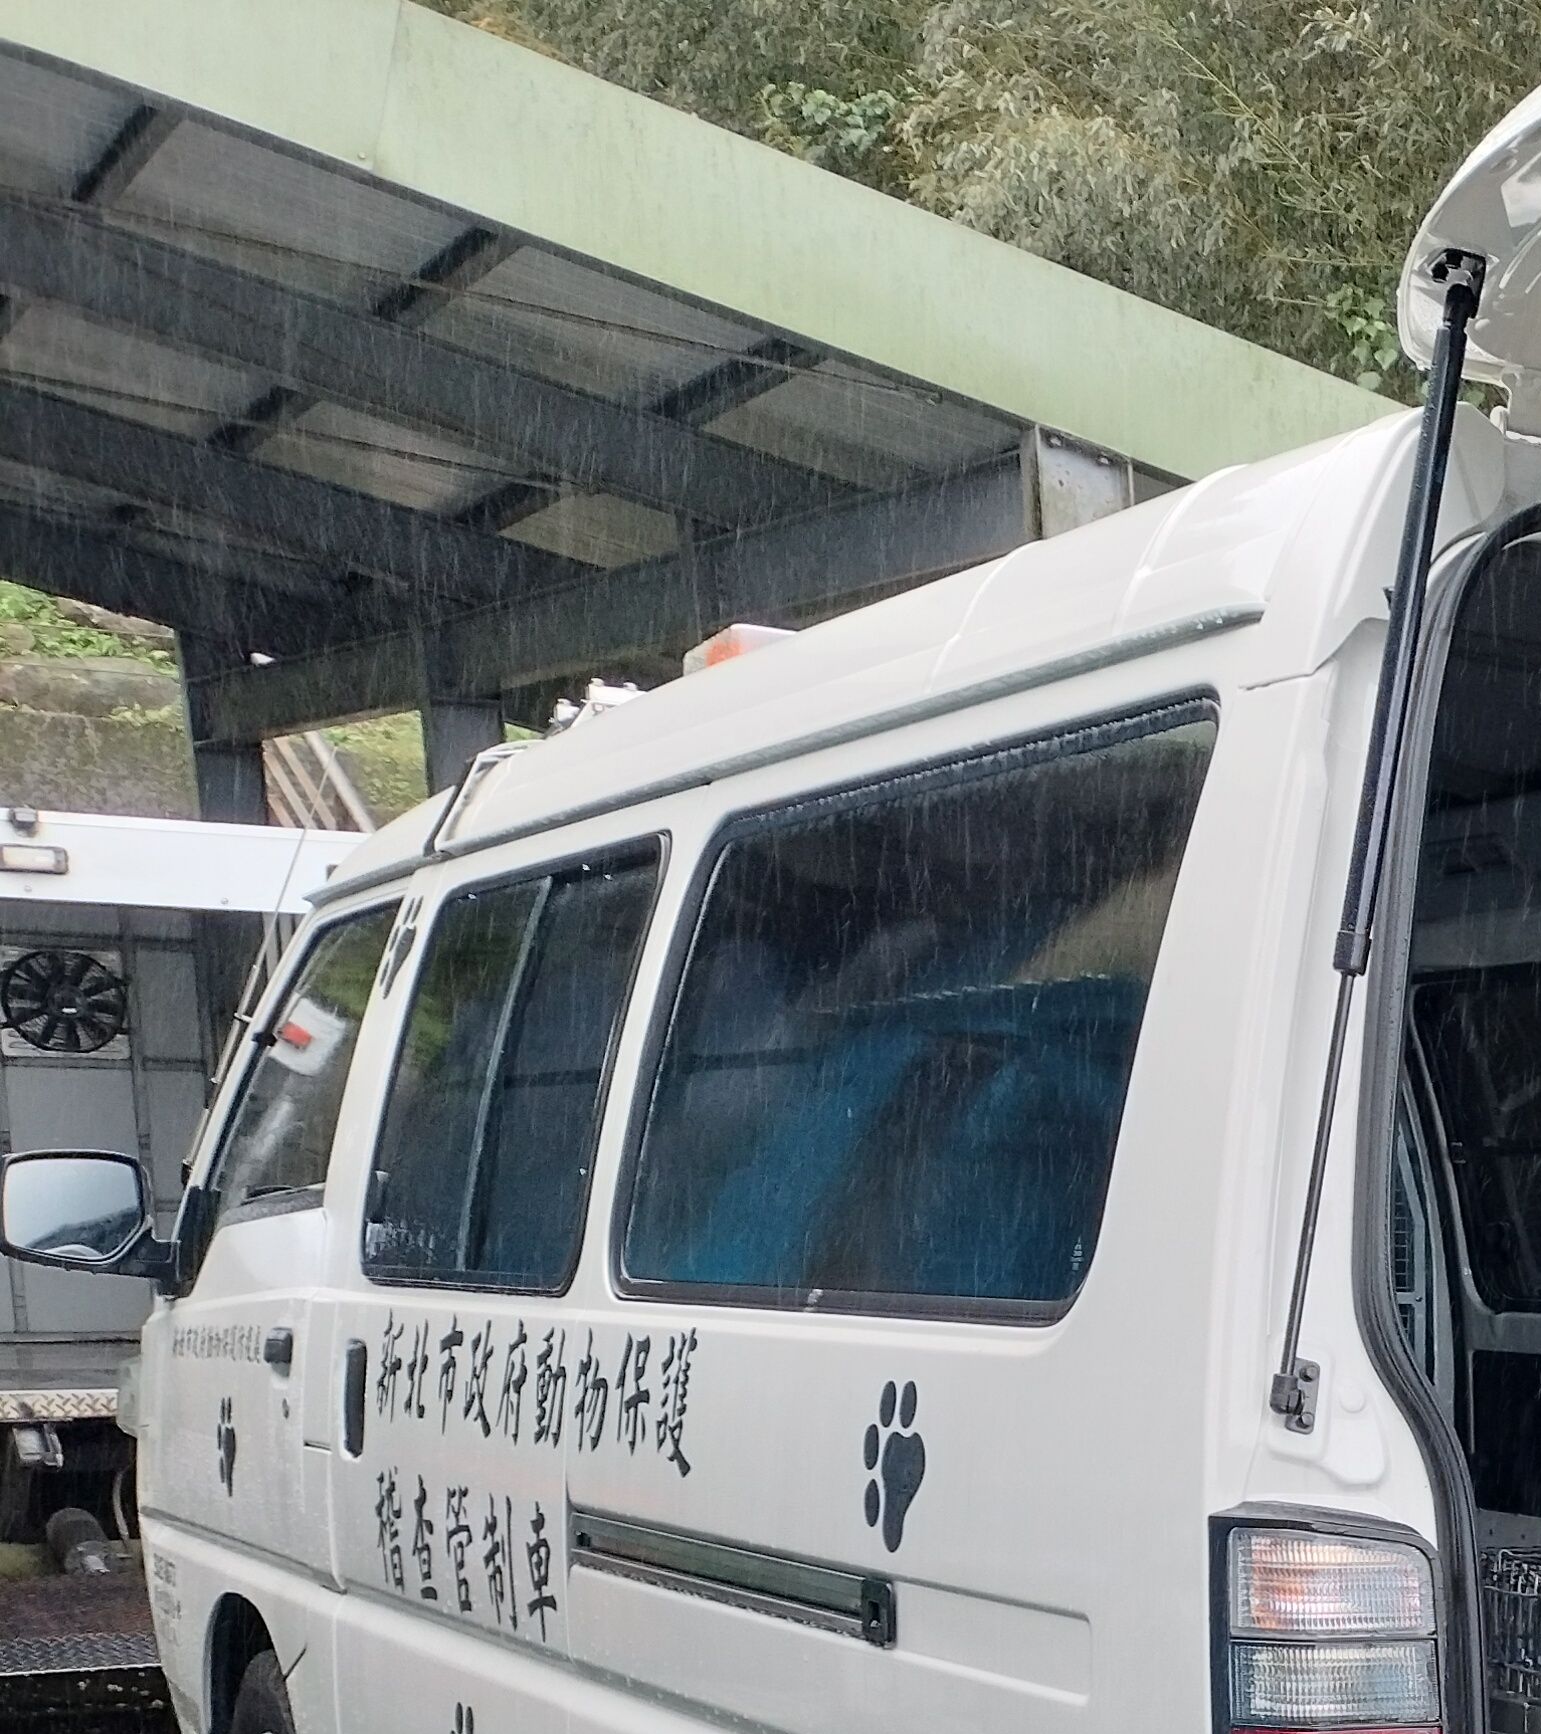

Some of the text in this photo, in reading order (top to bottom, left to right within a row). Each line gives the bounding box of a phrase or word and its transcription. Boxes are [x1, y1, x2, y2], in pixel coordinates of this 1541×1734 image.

[376, 1308, 698, 1478] 新北市政府動物保護
[375, 1465, 557, 1643] 稽查管制車
